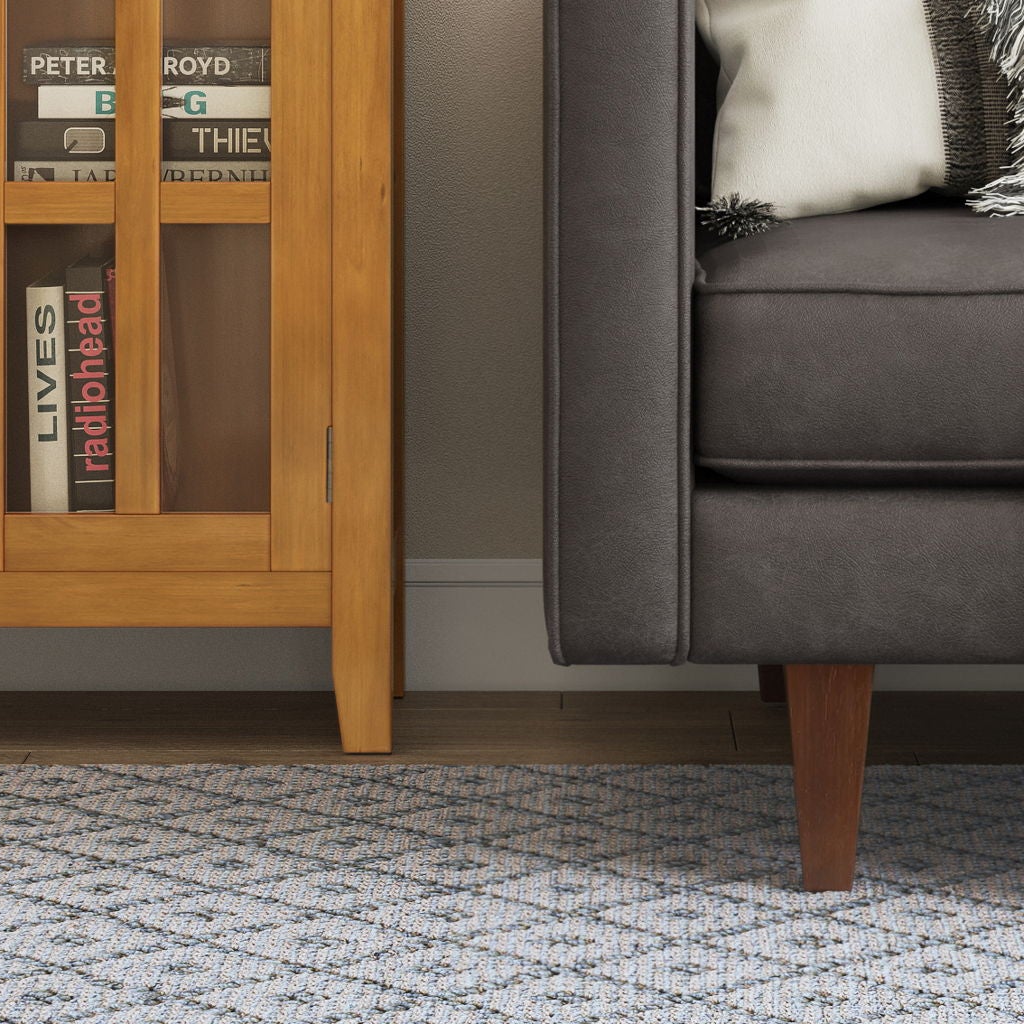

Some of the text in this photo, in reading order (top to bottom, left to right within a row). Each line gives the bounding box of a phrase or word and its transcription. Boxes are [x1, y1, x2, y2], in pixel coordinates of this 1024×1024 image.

[31, 56, 106, 75] PETER
[34, 303, 58, 442] LIVES
[69, 293, 109, 472] radiohead
